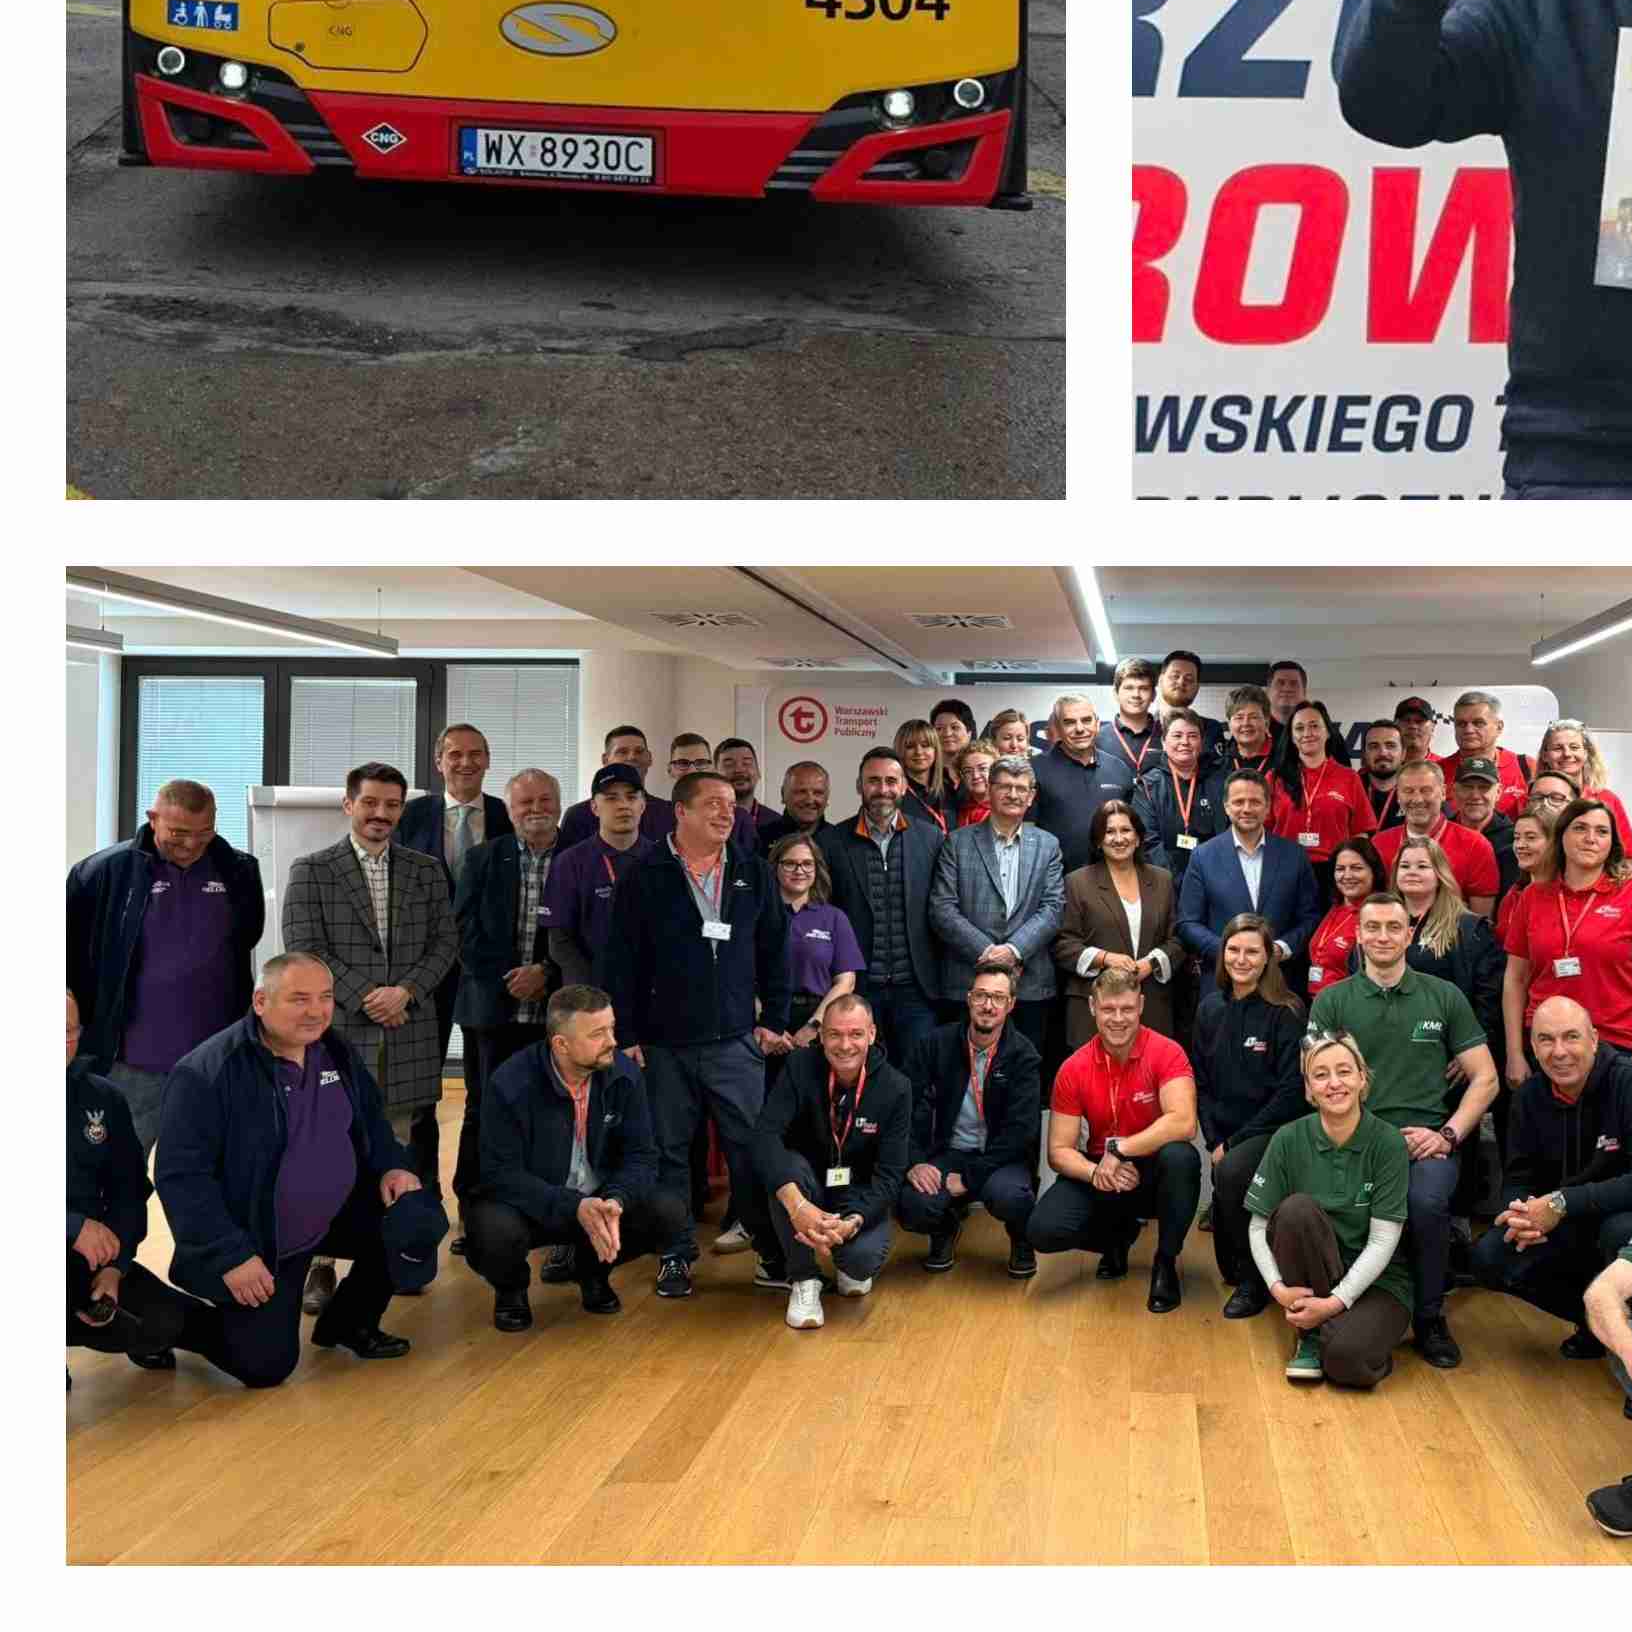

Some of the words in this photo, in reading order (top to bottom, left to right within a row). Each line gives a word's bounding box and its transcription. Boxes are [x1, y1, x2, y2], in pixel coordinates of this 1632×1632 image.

[329, 25, 353, 36] CNG
[370, 135, 399, 144] CNG
[485, 133, 526, 166] WX
[540, 137, 645, 172] 8930C
[1134, 394, 1475, 453] WSKIEGO
